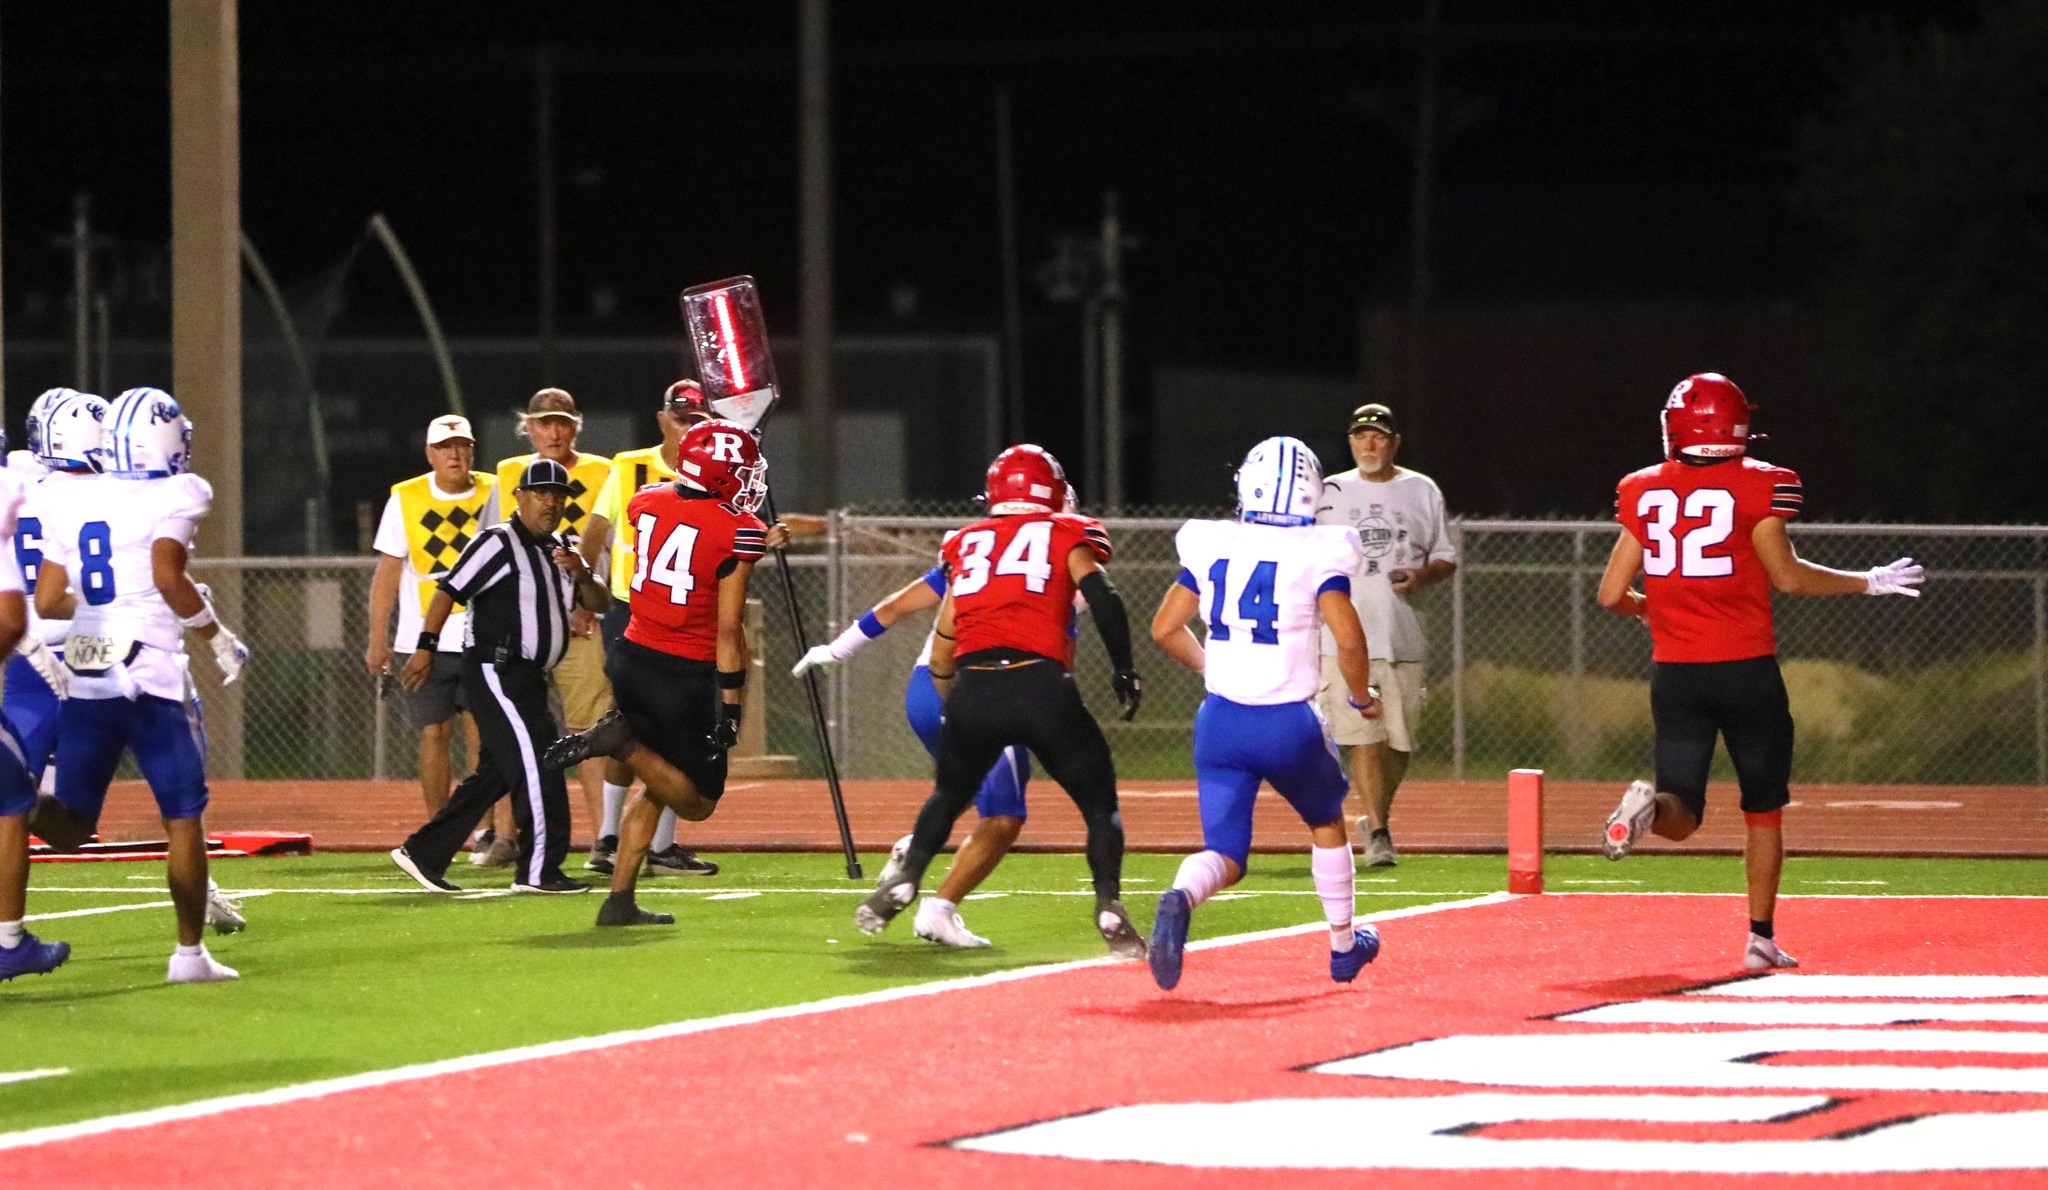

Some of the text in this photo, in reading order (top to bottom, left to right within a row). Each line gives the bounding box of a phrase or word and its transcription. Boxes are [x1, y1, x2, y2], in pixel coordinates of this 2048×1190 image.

[711, 432, 744, 463] R
[79, 521, 116, 606] 8
[632, 512, 700, 607] 14
[955, 521, 1053, 597] 34
[1637, 488, 1735, 577] 32
[1208, 557, 1279, 646] 14
[74, 645, 112, 664] NONE
